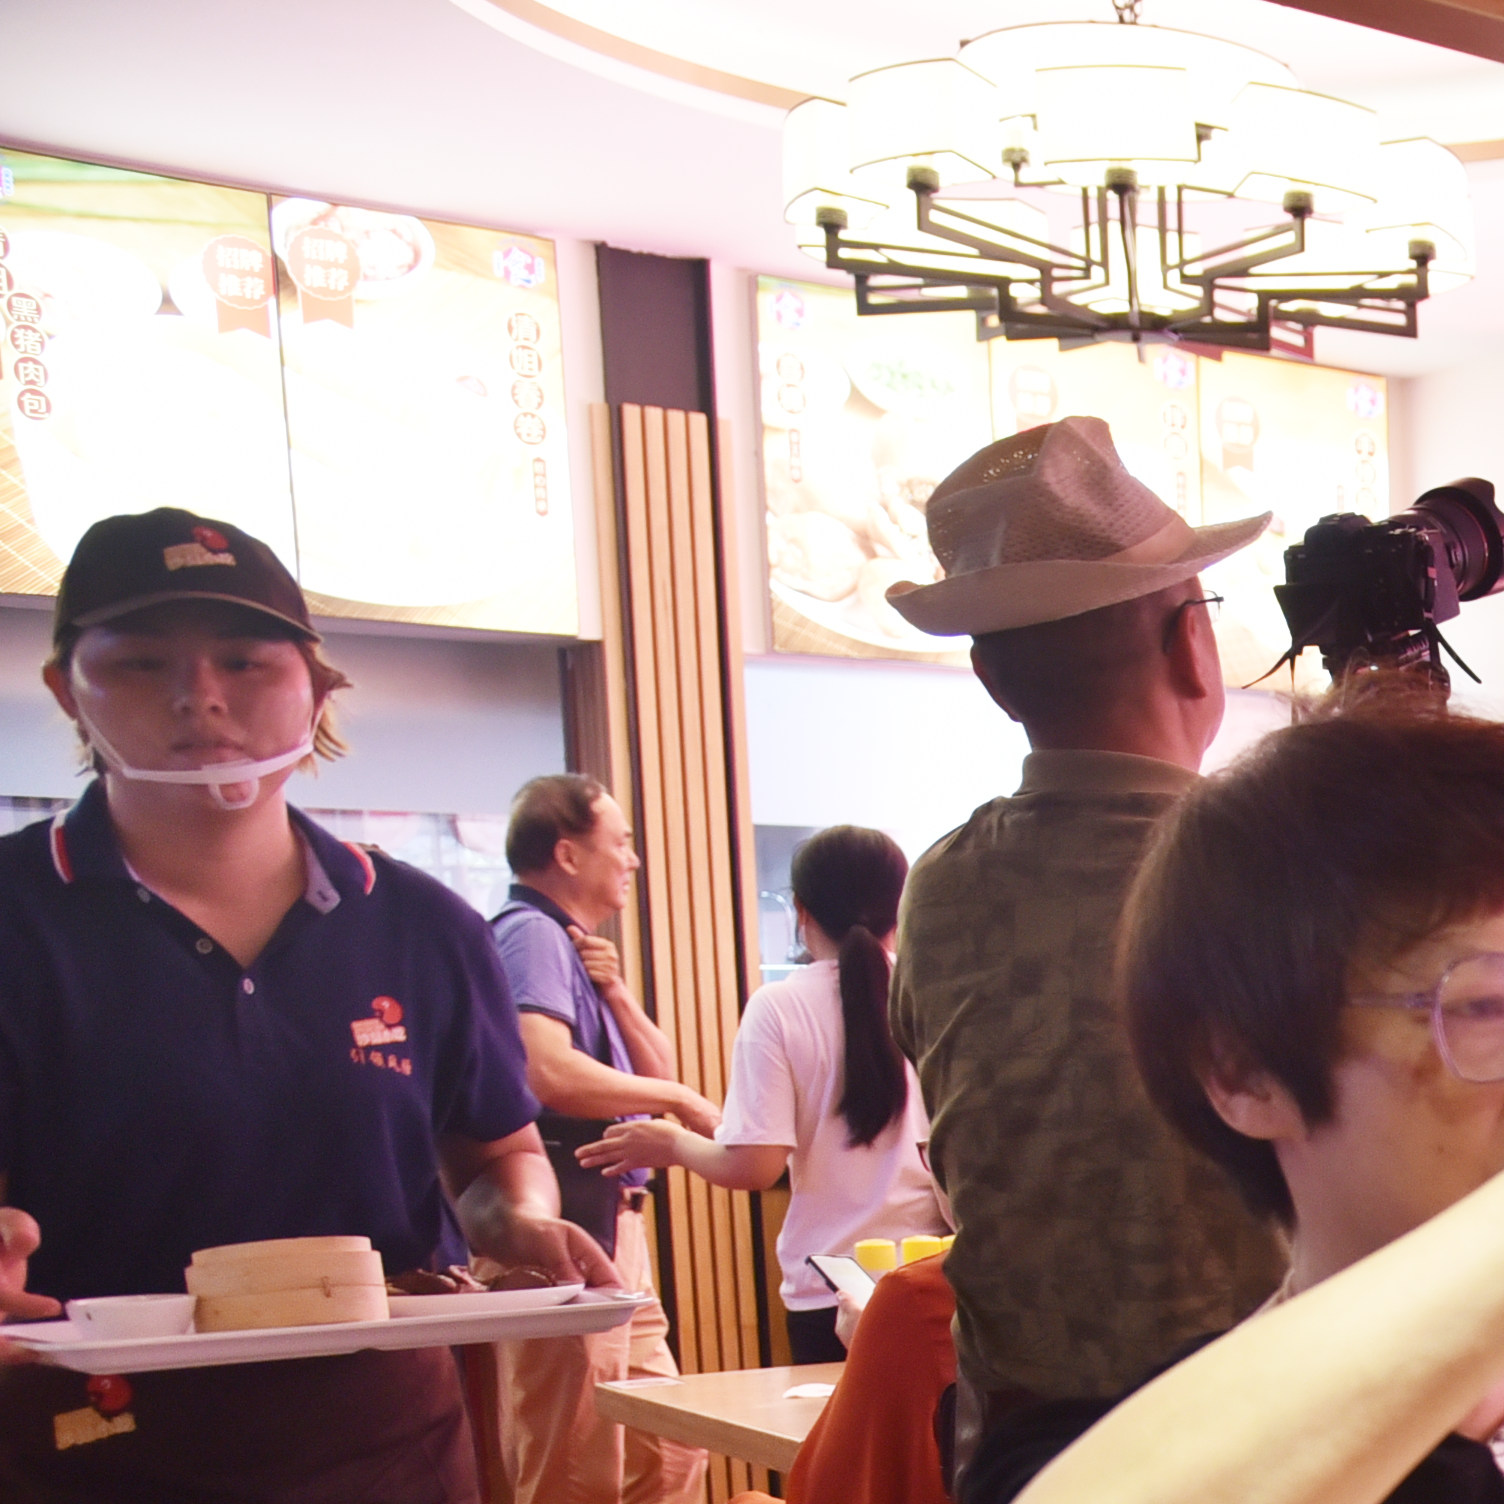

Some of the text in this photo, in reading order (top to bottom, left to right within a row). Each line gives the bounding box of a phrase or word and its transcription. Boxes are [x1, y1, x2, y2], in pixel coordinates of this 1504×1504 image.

[216, 245, 263, 275] 招牌
[301, 236, 348, 265] 招牌
[218, 274, 267, 301] 推荐
[303, 265, 350, 292] 推荐
[9, 295, 52, 420] 黑猪肉包
